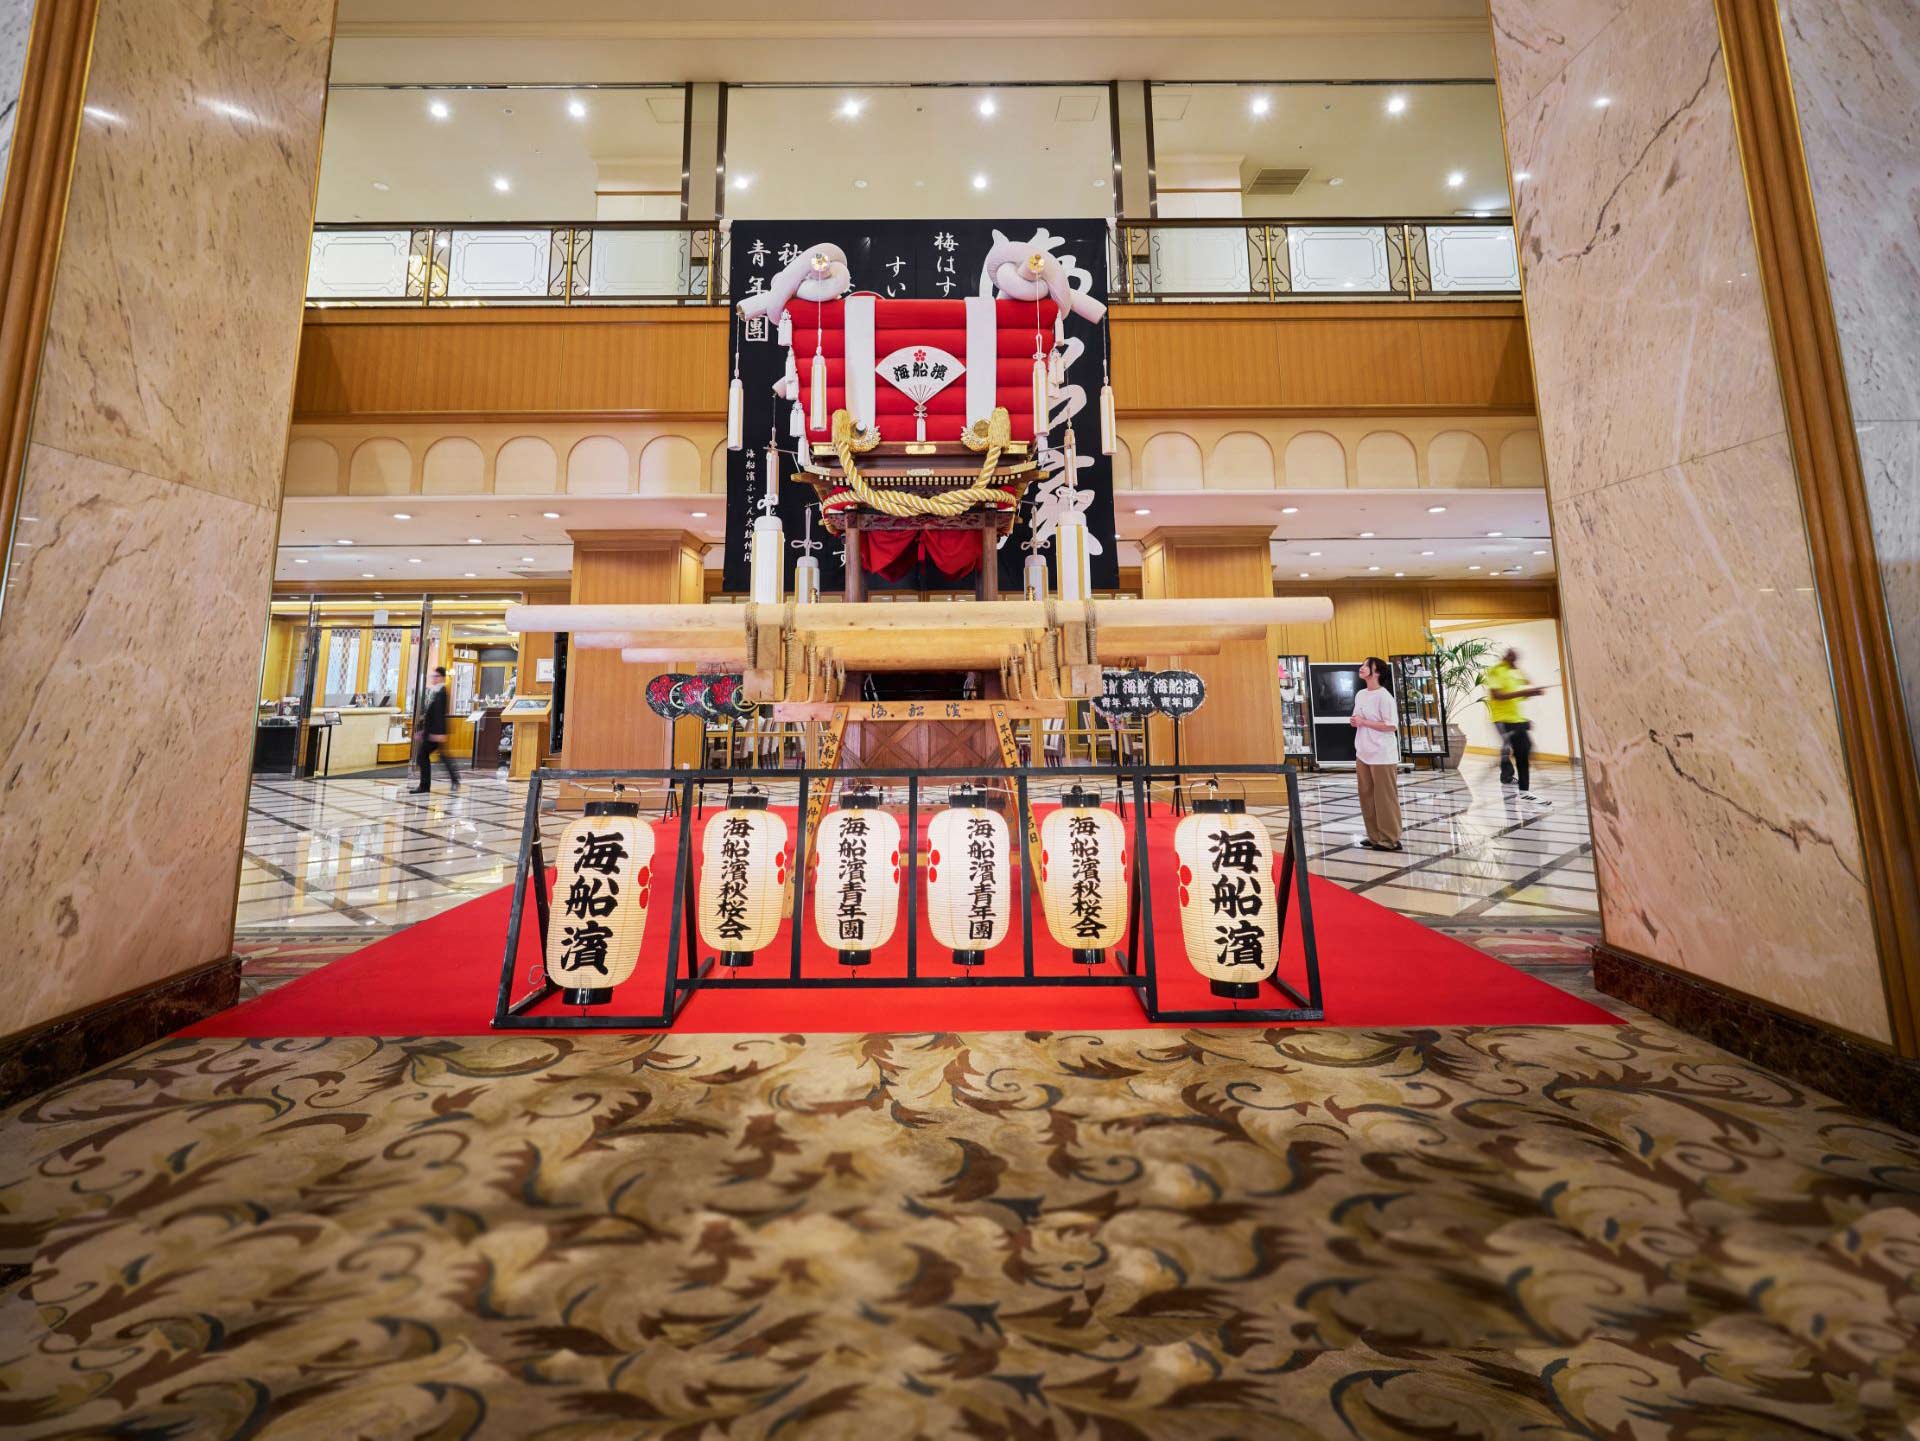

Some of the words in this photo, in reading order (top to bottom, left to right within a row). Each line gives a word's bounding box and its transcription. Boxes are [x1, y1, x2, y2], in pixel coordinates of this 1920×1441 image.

[560, 831, 629, 976] 海船濱
[715, 817, 755, 941] 海船濱秋桜会
[836, 817, 870, 941] 海船濱青年團
[966, 818, 997, 940] 海船濱青年團
[1068, 816, 1108, 939] 海船濱秋桜会
[1207, 830, 1265, 970] 海船濱
